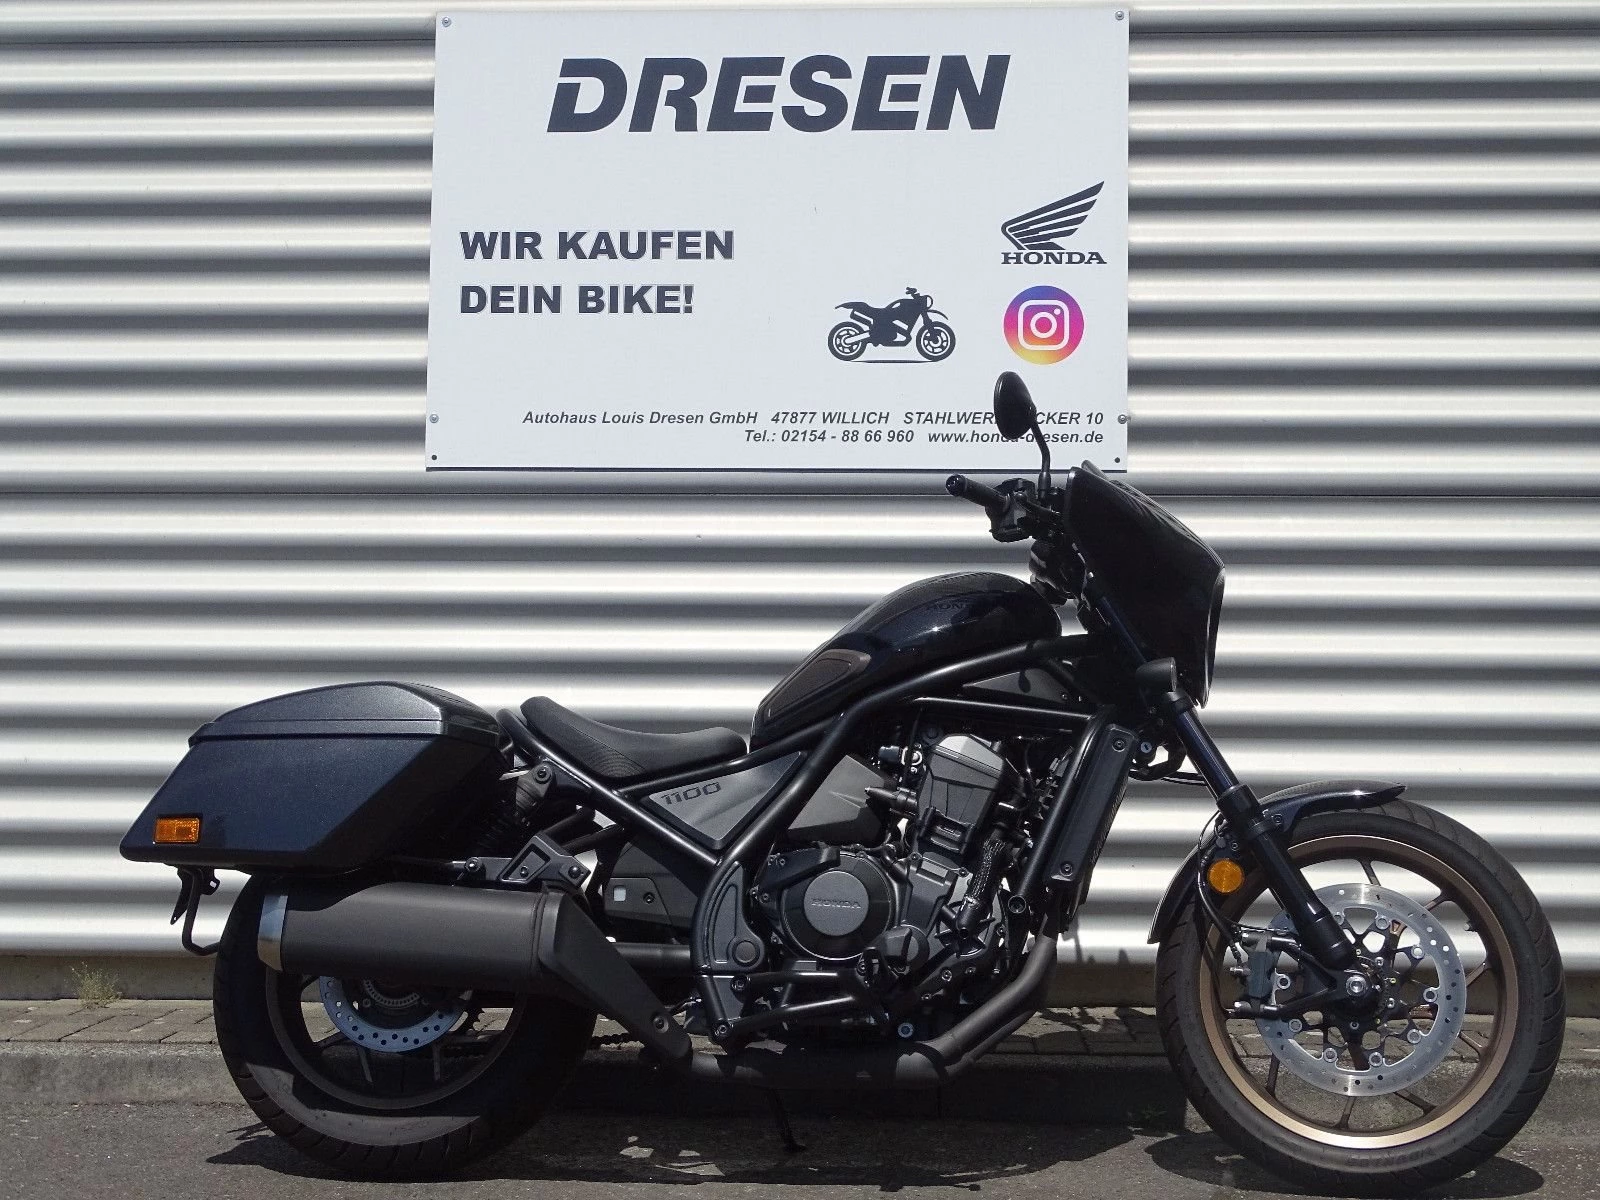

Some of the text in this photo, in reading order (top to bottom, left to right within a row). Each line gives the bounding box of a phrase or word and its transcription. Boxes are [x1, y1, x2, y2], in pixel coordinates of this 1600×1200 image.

[547, 54, 1012, 133] DRESEN
[460, 230, 734, 260] WIR KAUFEN
[1001, 251, 1107, 265] HONDA
[460, 285, 694, 314] DEIN BIKE!
[522, 411, 597, 424] Autohaus
[601, 411, 645, 424] Louis
[649, 411, 704, 424] Dresen
[709, 411, 759, 424] GmbH
[770, 411, 817, 424] 47877
[822, 411, 890, 425] WILLICH
[903, 411, 1004, 425] STAHLWER
[1086, 412, 1104, 425] 10
[744, 429, 777, 443] Tel.:
[781, 429, 827, 443] 02154
[841, 429, 860, 443] 88
[864, 429, 883, 443] 66
[886, 429, 915, 443] 960
[661, 782, 722, 805] 1100
